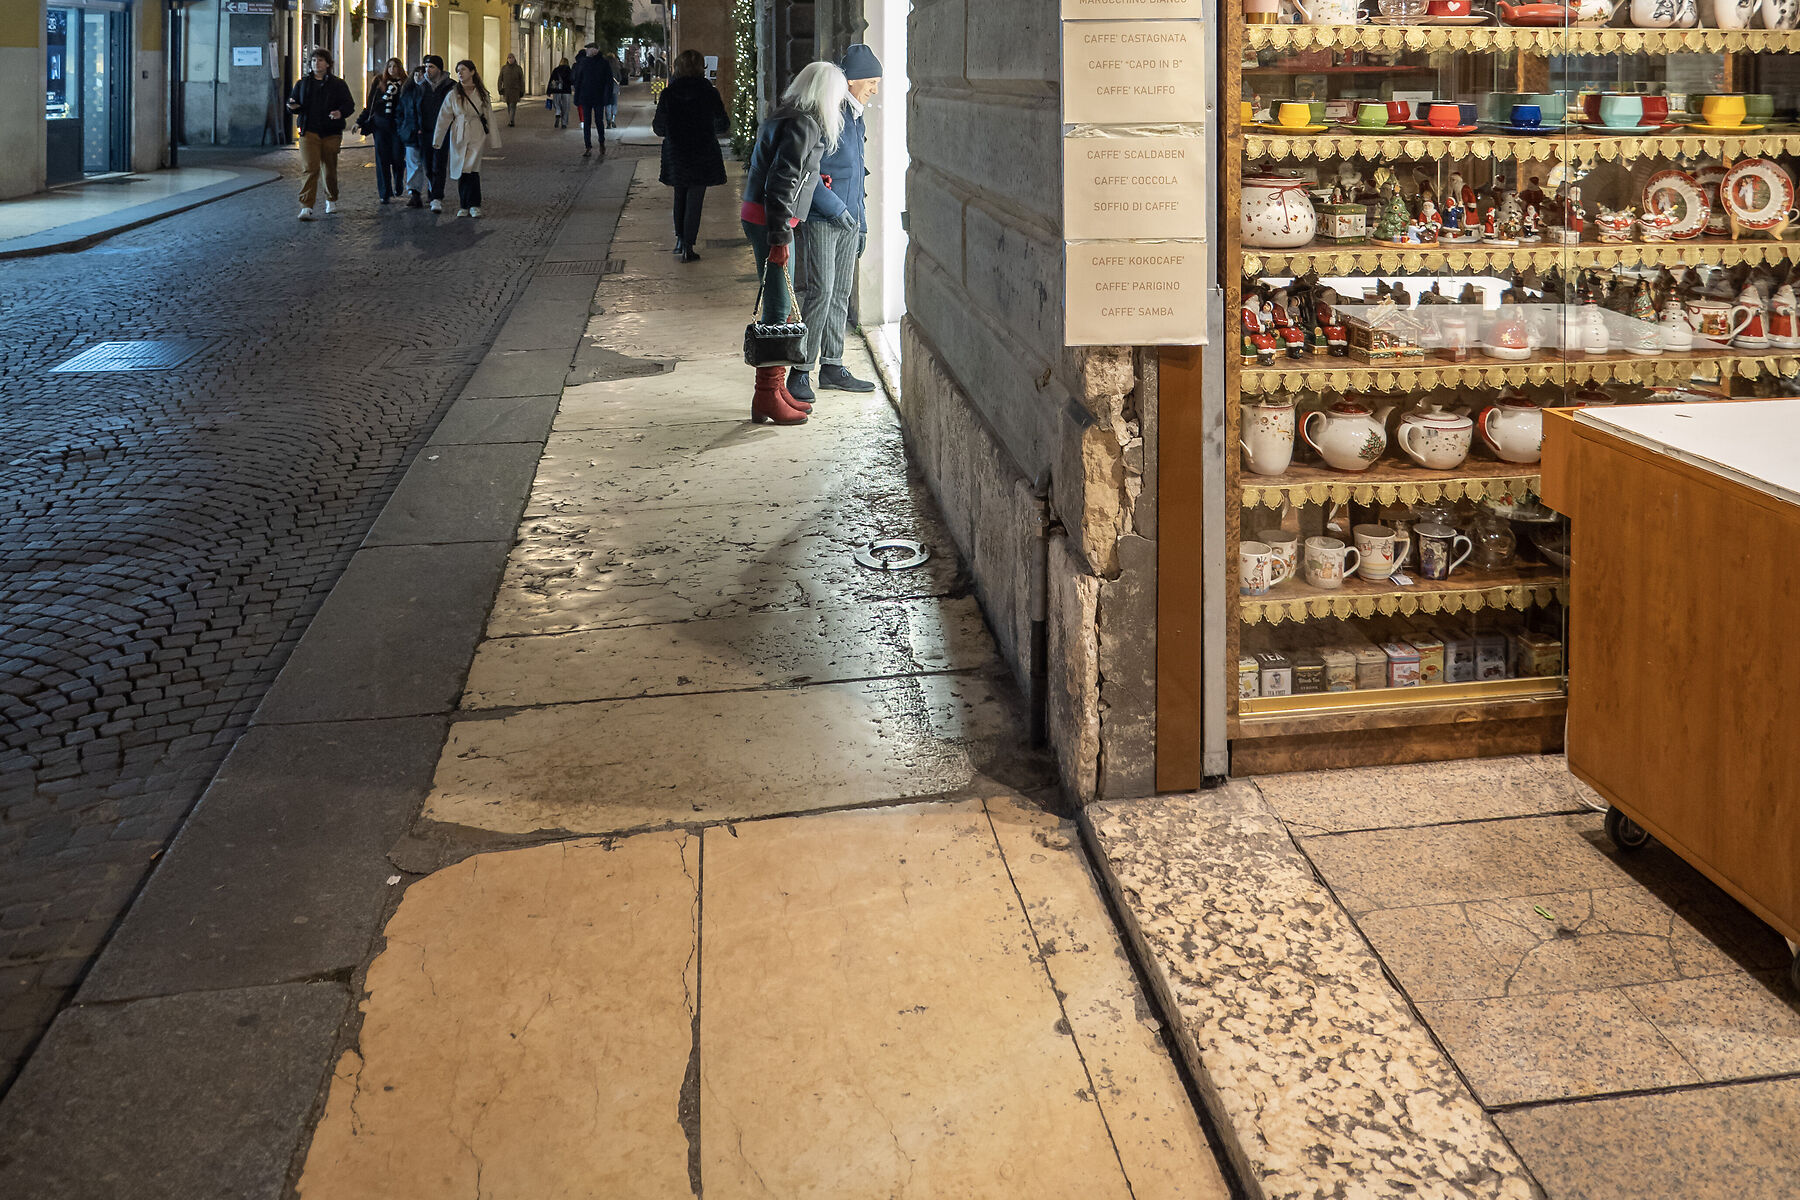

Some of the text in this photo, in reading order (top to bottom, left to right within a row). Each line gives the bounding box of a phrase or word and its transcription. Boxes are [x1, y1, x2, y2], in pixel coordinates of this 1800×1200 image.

[1084, 34, 1187, 43] CAFFE' CASTAGNATA
[1088, 60, 1123, 69] CAFFE'
[1159, 60, 1169, 69] IN
[1096, 85, 1176, 95] CAFFE' KALIFFO
[1087, 150, 1185, 159] CAFFE' SCALDABEN
[1094, 176, 1178, 185] CAFFE' COCCOLA
[1093, 201, 1179, 211] SOFFIO DI CAFFE'
[1091, 256, 1185, 266] CAFFE' KOKOCAFE'
[1095, 281, 1180, 291] CAFFE' PARIGINO
[1101, 307, 1174, 317] CAFFE' SAMBA
[1257, 651, 1285, 662] TEA
